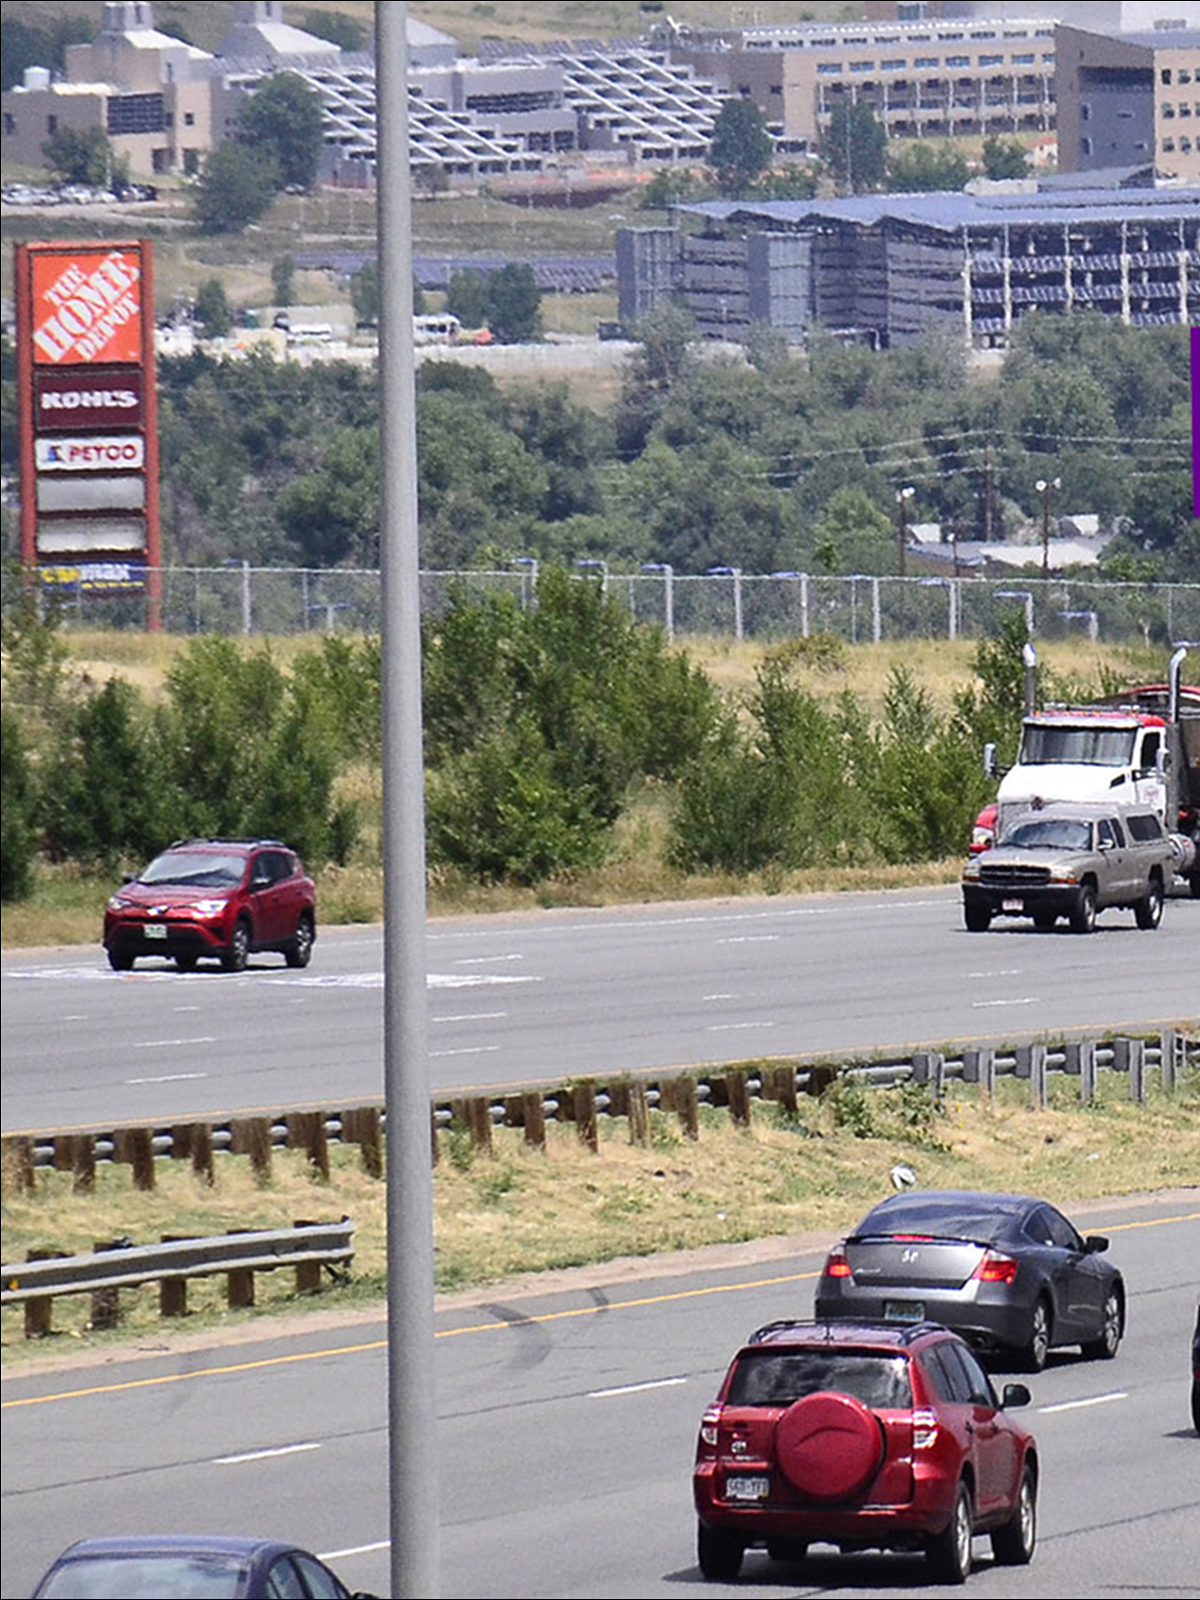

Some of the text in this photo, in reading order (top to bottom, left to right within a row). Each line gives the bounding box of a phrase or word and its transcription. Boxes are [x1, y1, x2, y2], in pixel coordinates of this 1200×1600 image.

[45, 264, 88, 306] THE
[33, 252, 139, 361] HOME
[75, 293, 139, 361] DEPOT
[41, 390, 138, 409] KOHL'S
[69, 445, 137, 462] PETCO
